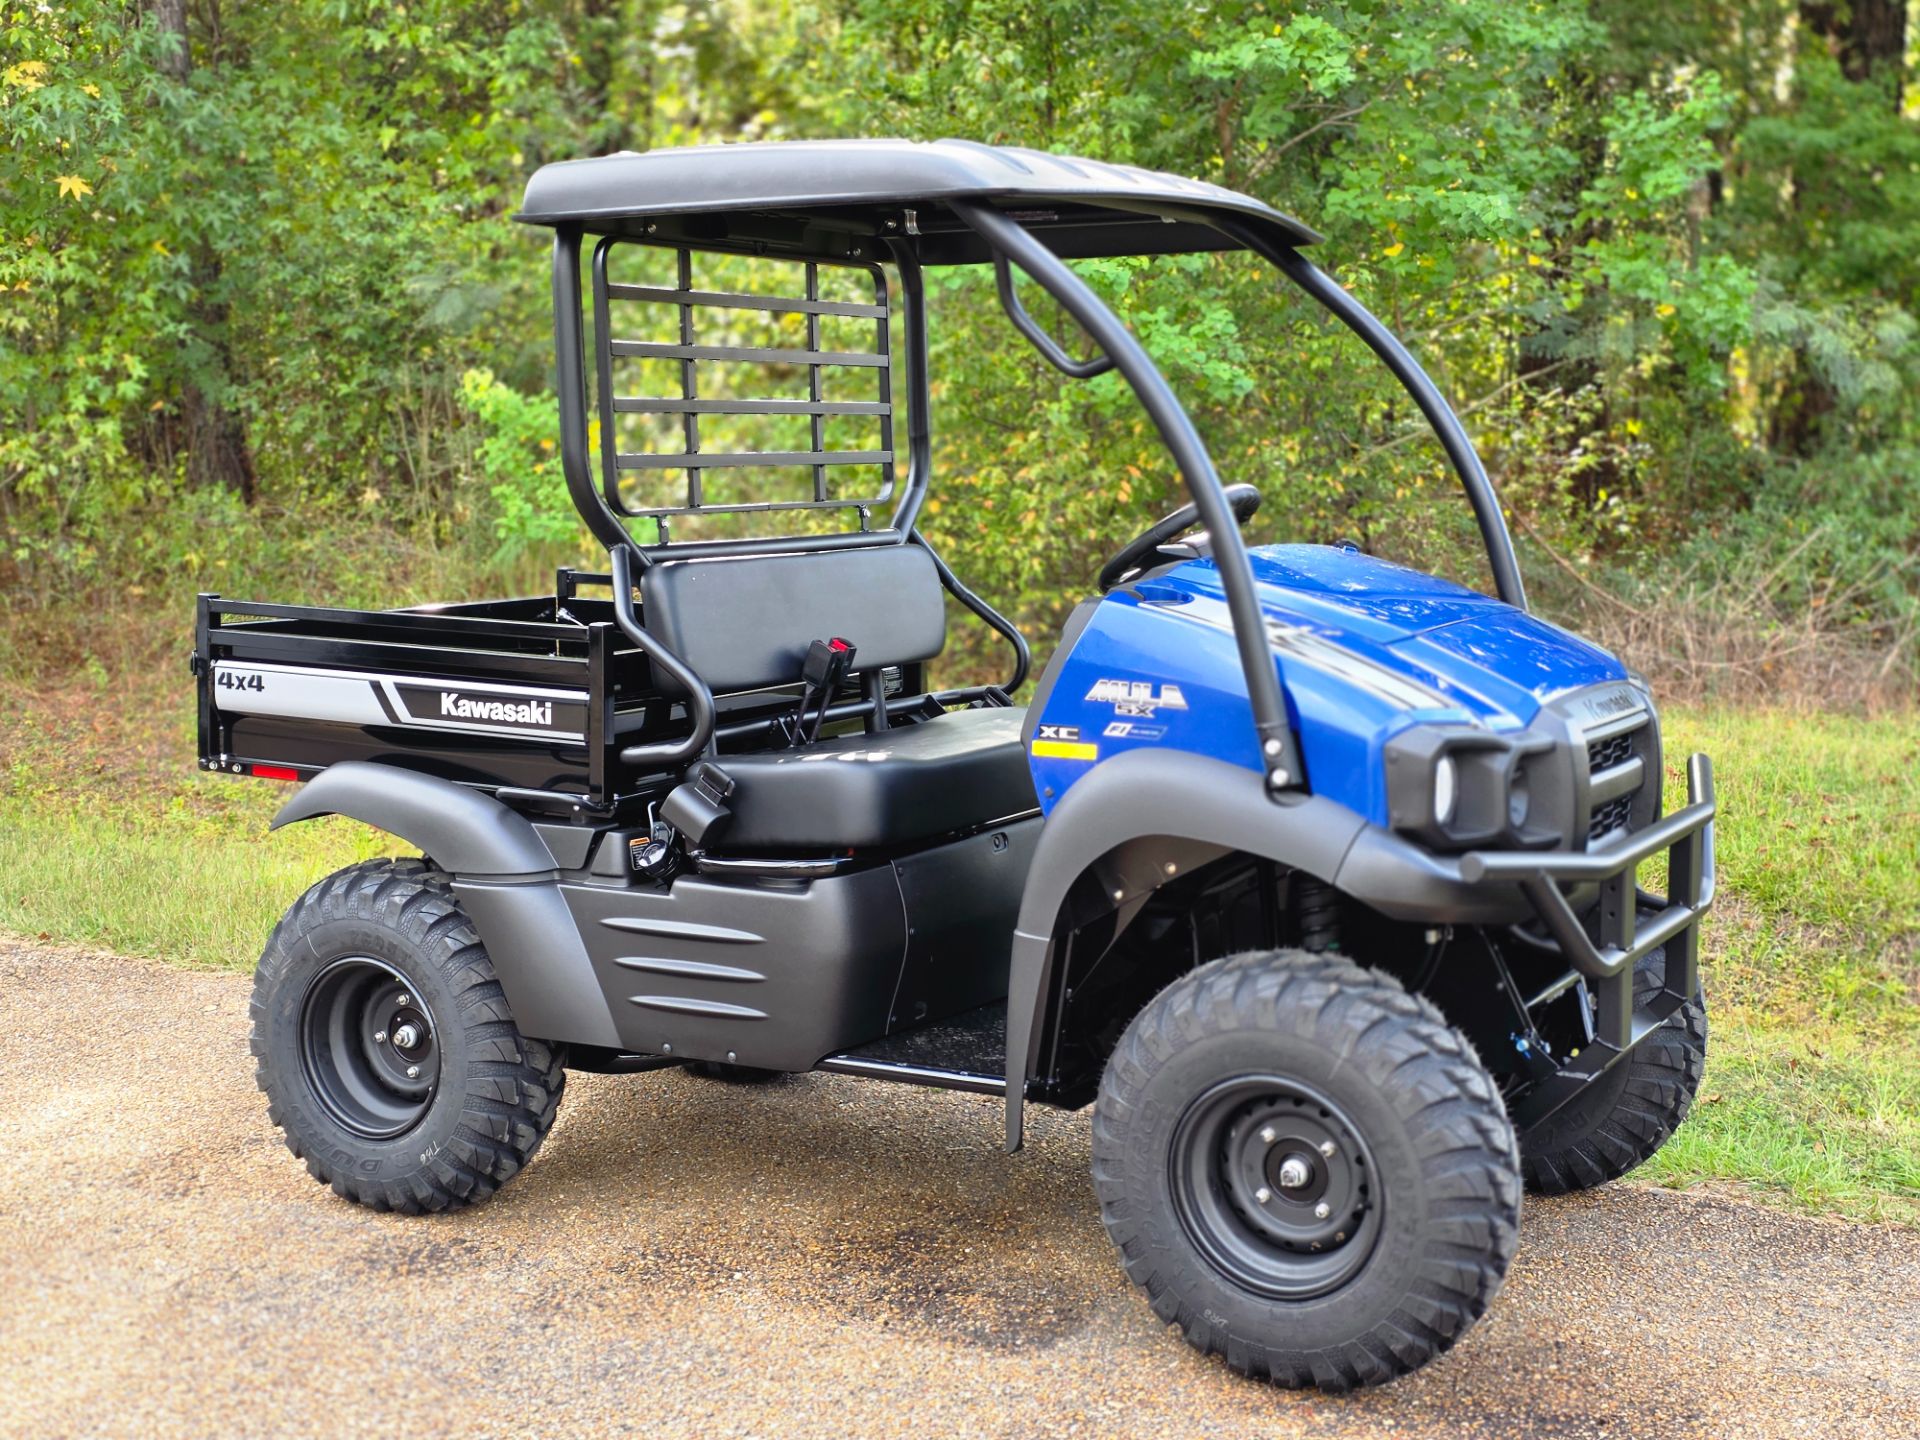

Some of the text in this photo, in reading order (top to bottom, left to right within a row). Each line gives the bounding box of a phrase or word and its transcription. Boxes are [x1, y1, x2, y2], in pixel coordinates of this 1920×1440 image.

[217, 671, 265, 693] 4x4
[440, 692, 552, 726] Kawasaki
[1039, 726, 1079, 740] XC
